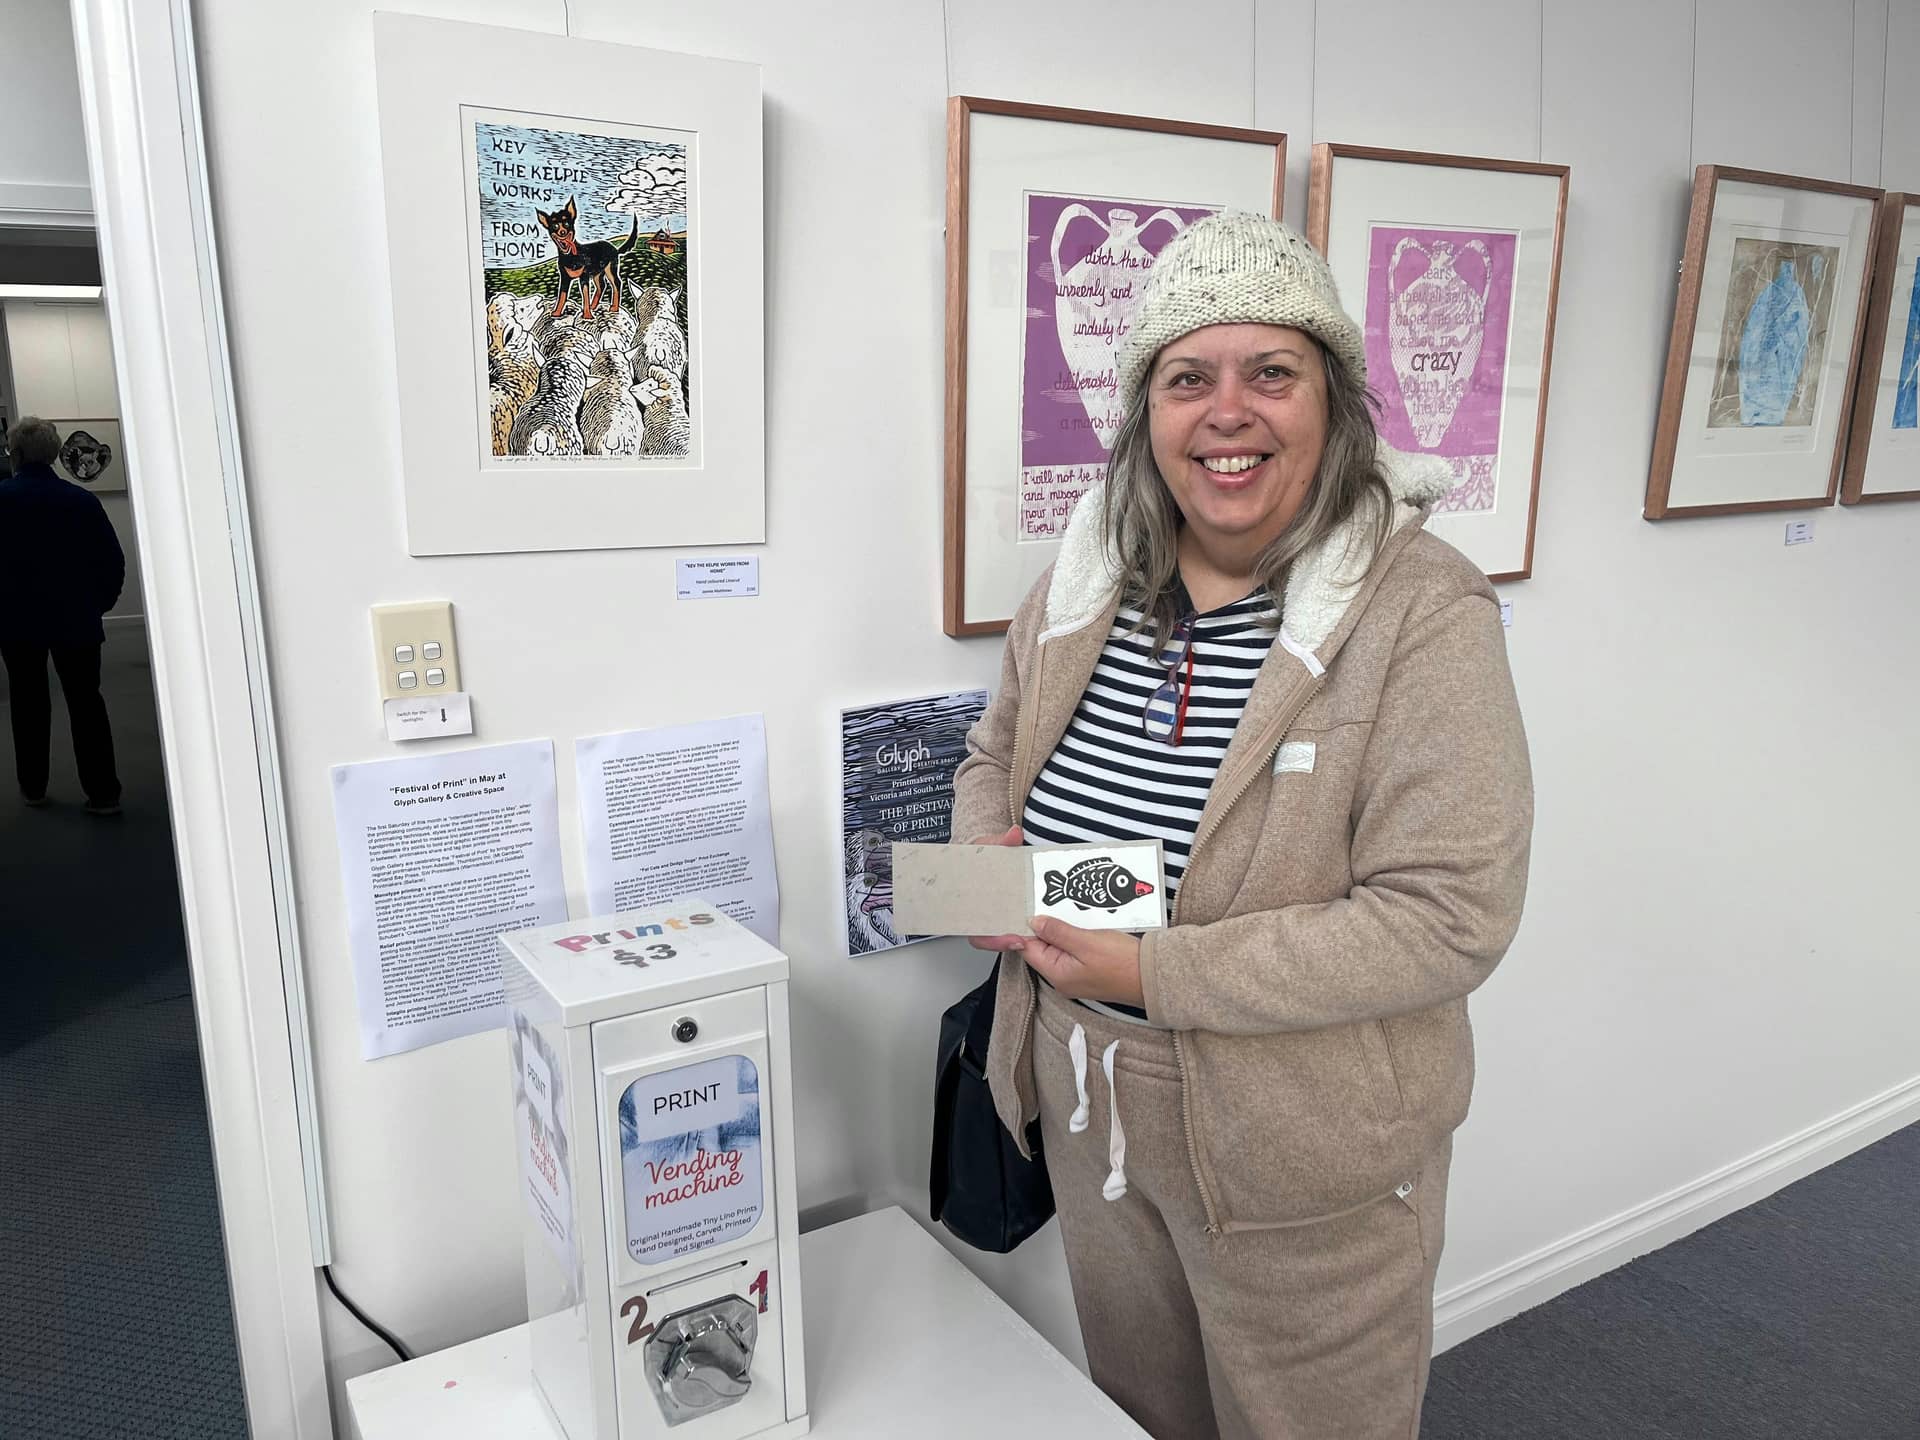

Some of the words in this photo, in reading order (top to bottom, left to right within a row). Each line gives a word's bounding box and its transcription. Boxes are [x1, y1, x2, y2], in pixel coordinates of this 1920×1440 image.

[492, 137, 527, 154] KEV
[492, 161, 526, 178] THE
[531, 166, 588, 183] KELPIE
[492, 183, 551, 200] WORKS
[491, 221, 540, 237] FROM
[495, 242, 545, 258] HOME
[1085, 245, 1115, 266] ditch
[1119, 251, 1139, 269] the
[1111, 282, 1133, 299] and
[1411, 351, 1462, 376] crazy
[1054, 368, 1118, 398] deliberately
[1060, 419, 1069, 430] a
[1031, 470, 1053, 485] will
[1057, 470, 1075, 484] not
[1079, 468, 1093, 483] be
[1024, 490, 1045, 501] and
[1025, 508, 1046, 520] now
[1052, 504, 1070, 517] not
[876, 739, 931, 772] Glyph
[892, 776, 935, 788] Printmakers
[935, 773, 944, 781] of
[394, 798, 416, 806] Glyph
[453, 790, 482, 798] Creative
[483, 786, 504, 794] Space
[870, 791, 898, 802] Victoria
[899, 788, 912, 797] and
[913, 783, 934, 795] South
[935, 783, 955, 792] Austr
[880, 806, 904, 820] THE
[893, 821, 909, 833] OF
[911, 815, 946, 831] PRINT
[917, 832, 937, 842] Sunday
[554, 913, 715, 953] Prints
[613, 943, 677, 969] $3
[527, 1063, 546, 1100] PRINT
[653, 1082, 721, 1115] PRINT
[643, 1148, 743, 1185] Vending
[645, 1171, 744, 1210] machine
[630, 1231, 660, 1247] Original
[661, 1221, 701, 1238] Handmade
[703, 1215, 718, 1226] Tiny
[720, 1211, 735, 1221] Lino
[737, 1205, 757, 1216] Prints
[636, 1244, 656, 1255] Hand
[658, 1234, 695, 1249] Designed,
[696, 1226, 724, 1238] Carved,
[725, 1216, 751, 1229] Printed
[673, 1245, 688, 1255] and
[749, 1269, 769, 1314] 1
[620, 1295, 655, 1345] 2
